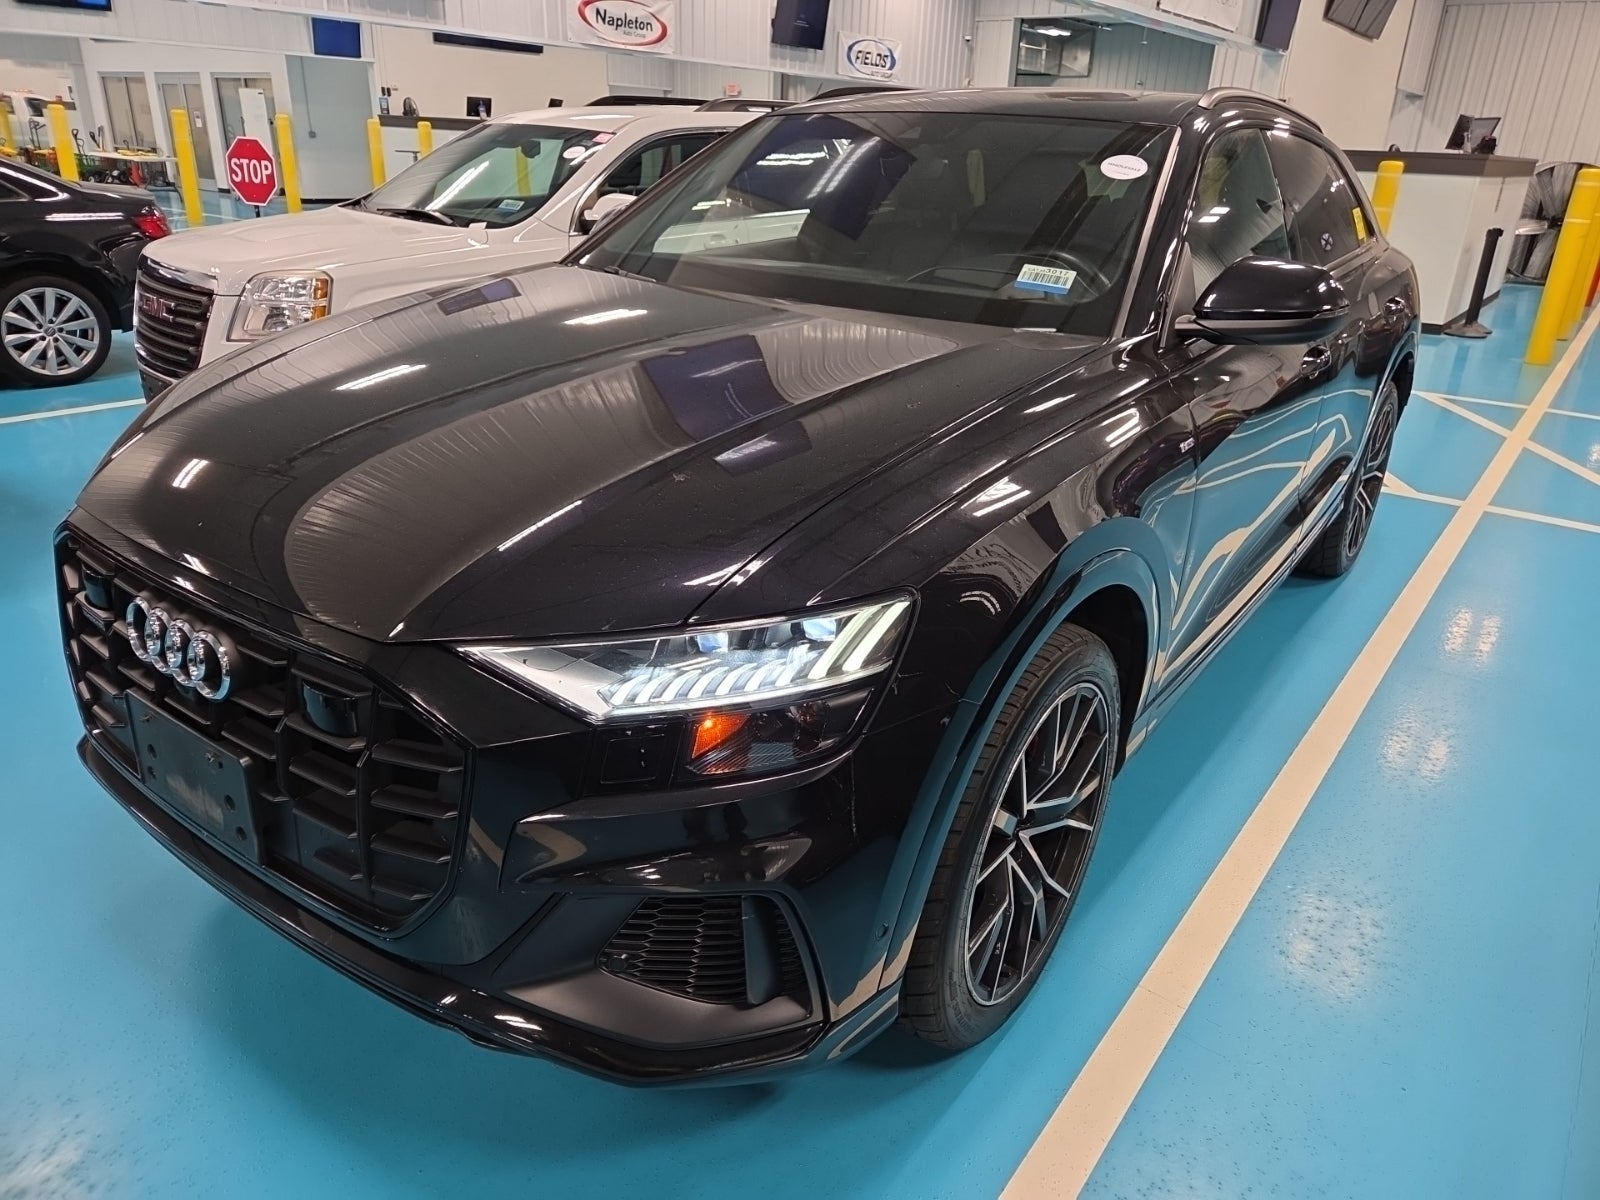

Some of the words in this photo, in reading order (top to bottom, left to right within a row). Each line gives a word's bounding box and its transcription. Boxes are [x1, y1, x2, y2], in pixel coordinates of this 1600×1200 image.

[595, 7, 653, 32] Napleton
[855, 50, 889, 69] FIELDS
[231, 157, 272, 185] STOP
[140, 292, 175, 322] GMC
